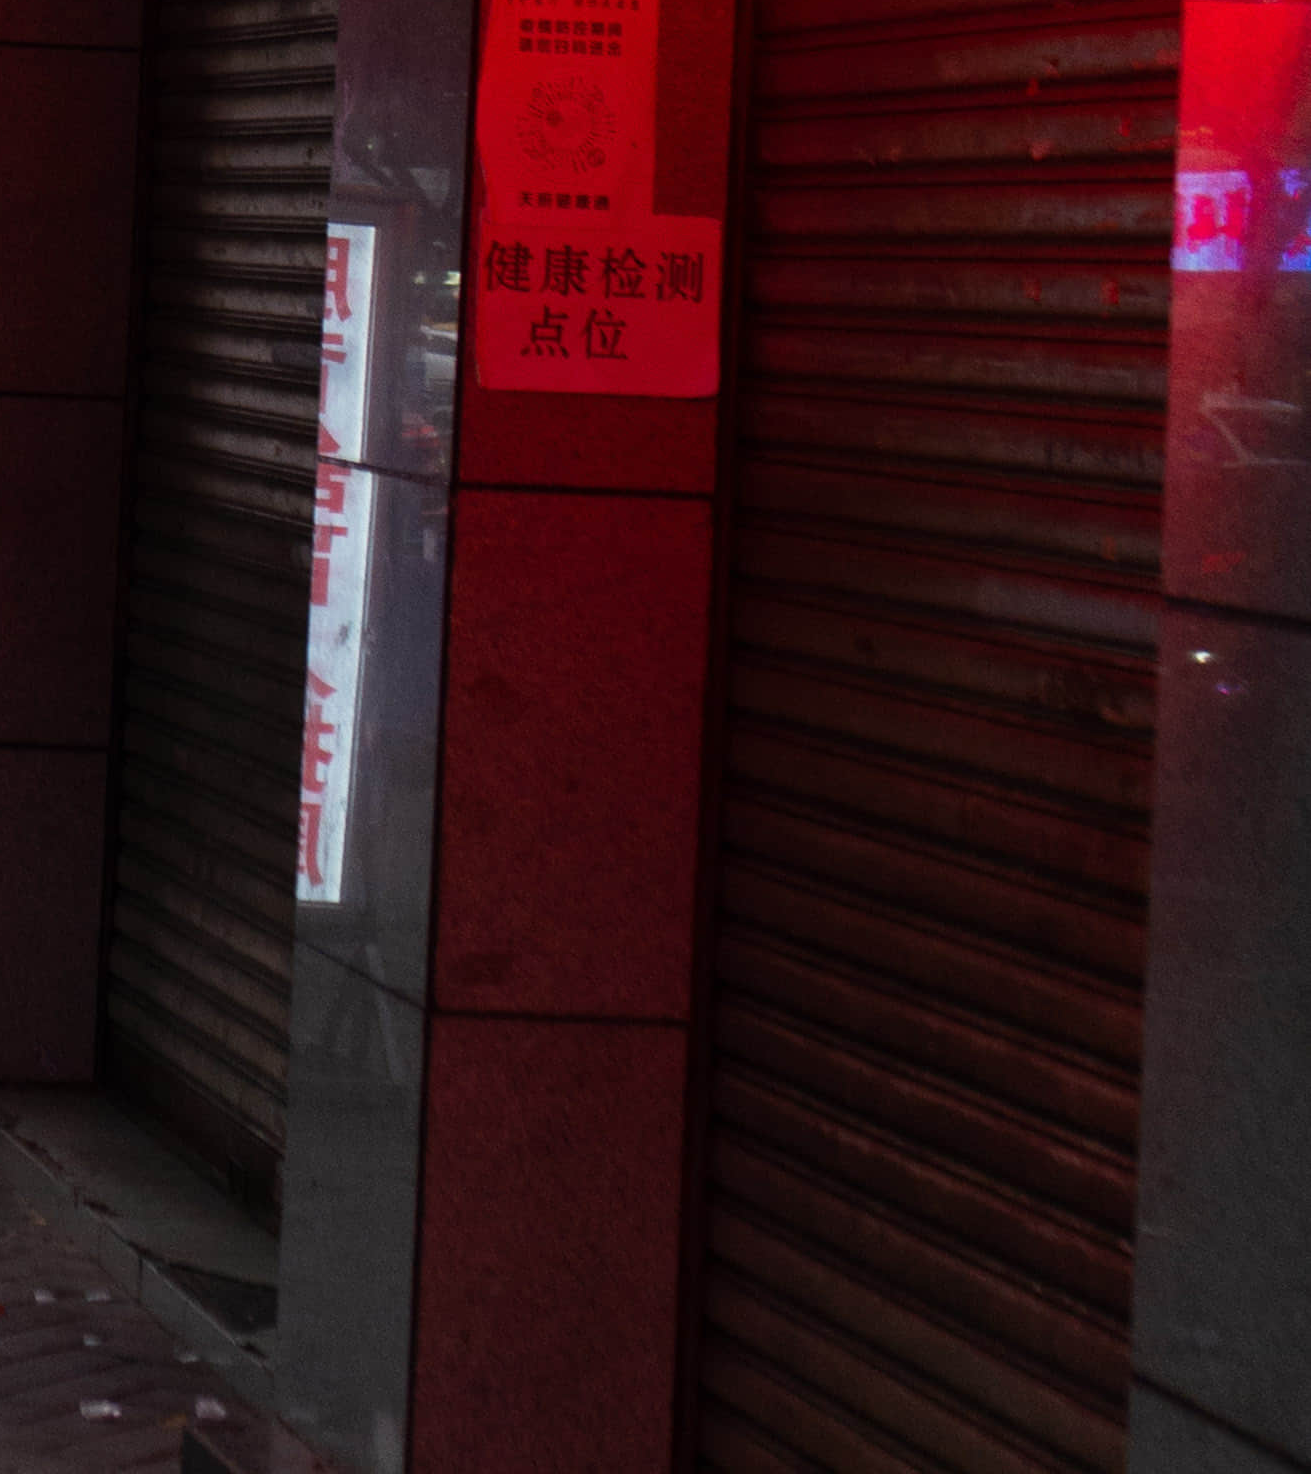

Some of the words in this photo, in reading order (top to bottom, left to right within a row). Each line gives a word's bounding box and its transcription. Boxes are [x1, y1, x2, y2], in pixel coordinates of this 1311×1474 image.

[484, 239, 707, 305] 健康检测
[519, 306, 629, 362] 点位
